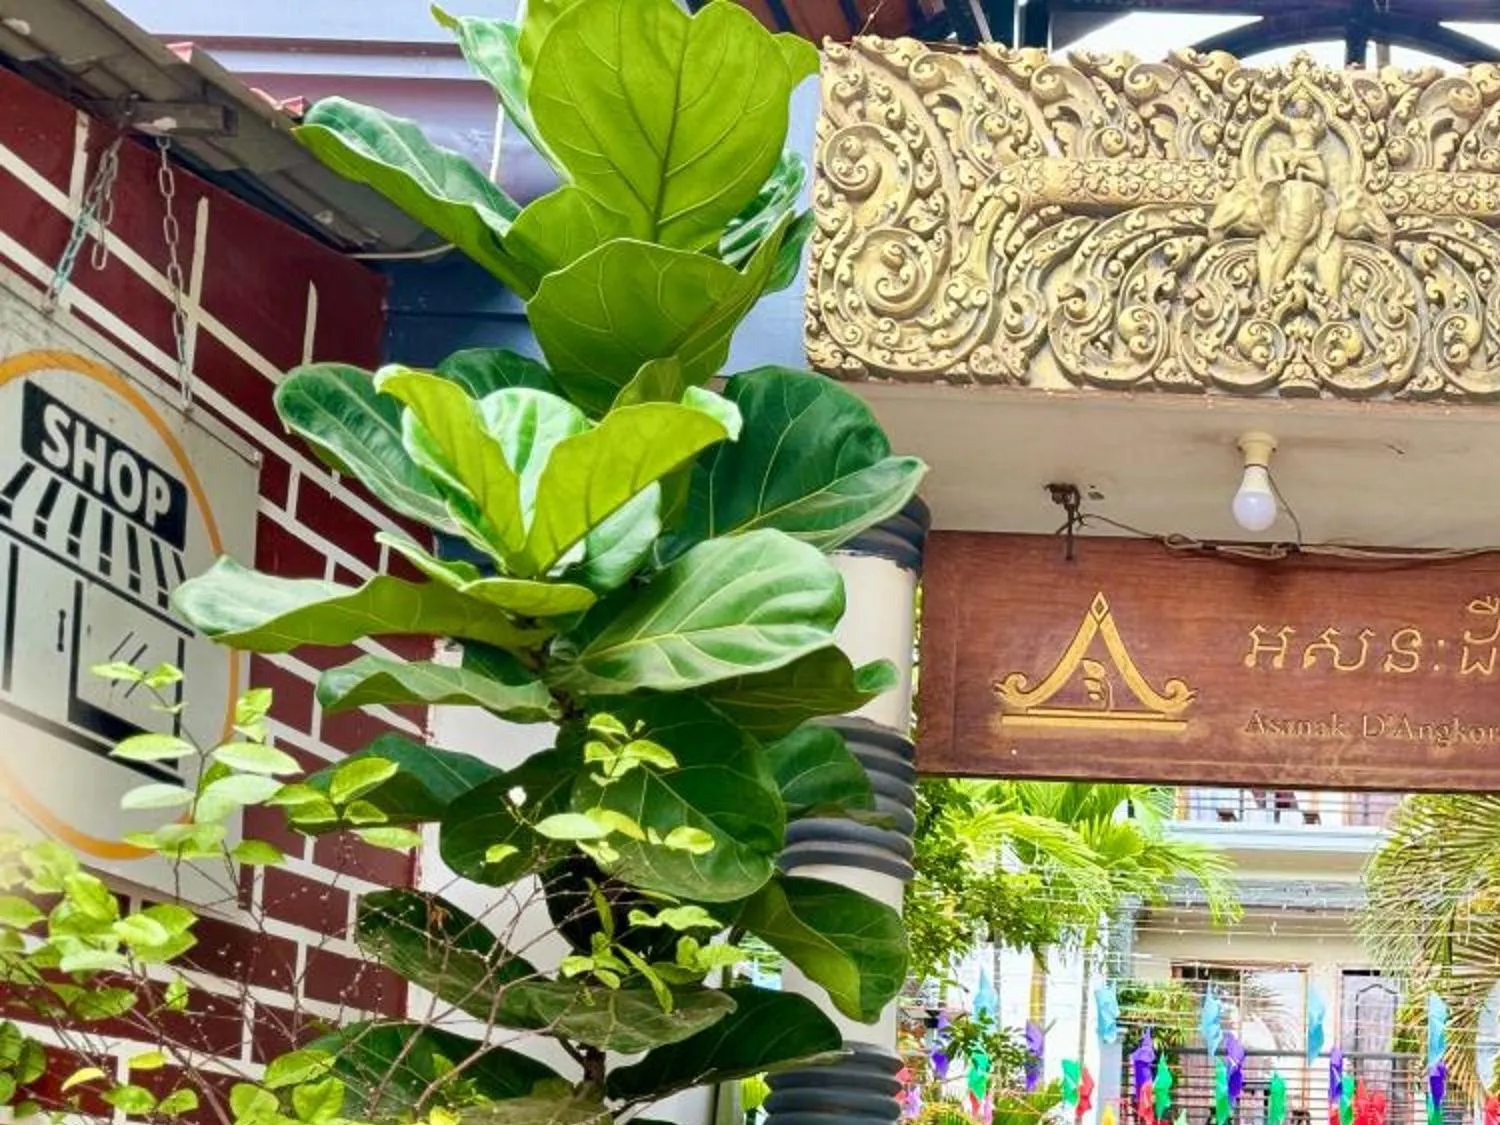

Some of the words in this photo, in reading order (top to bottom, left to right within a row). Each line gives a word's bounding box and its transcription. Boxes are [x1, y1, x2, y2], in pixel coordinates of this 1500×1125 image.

[41, 403, 173, 532] SHOP
[1243, 707, 1346, 740] Asanak
[1362, 712, 1499, 749] D'Angkor
